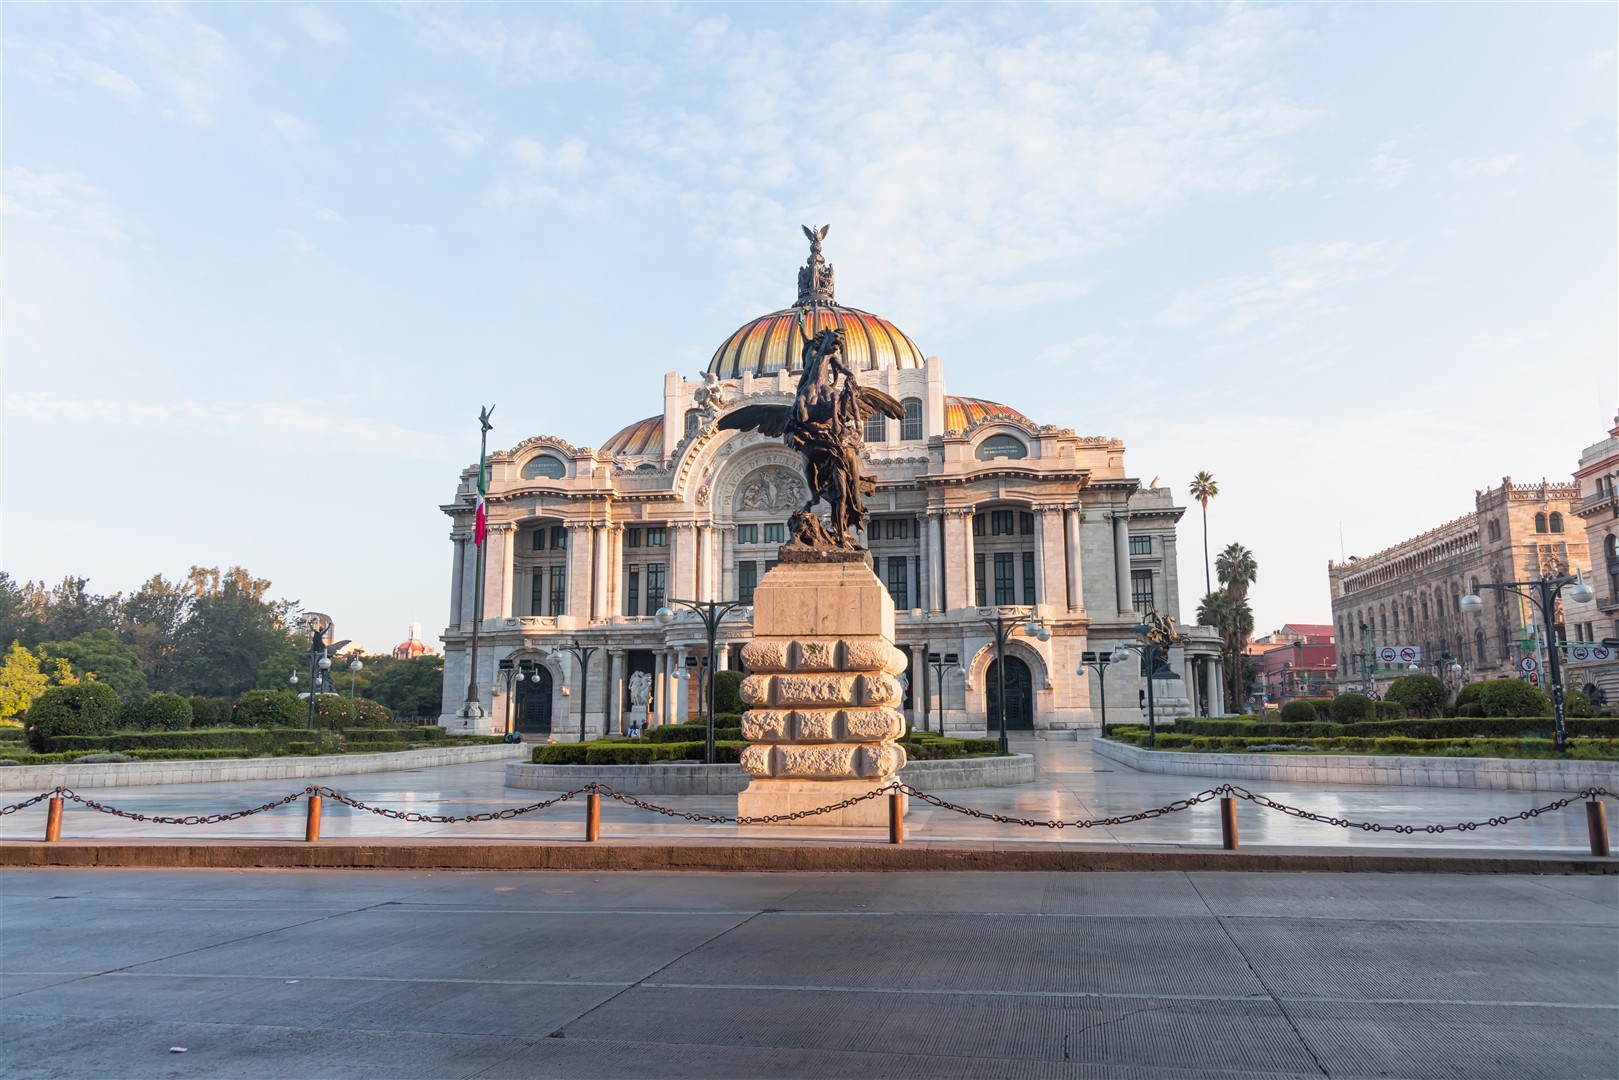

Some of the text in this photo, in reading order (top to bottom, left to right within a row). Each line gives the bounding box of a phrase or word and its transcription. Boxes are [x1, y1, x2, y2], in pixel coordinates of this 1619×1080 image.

[723, 456, 803, 506] PALACIO DE BELLAS
